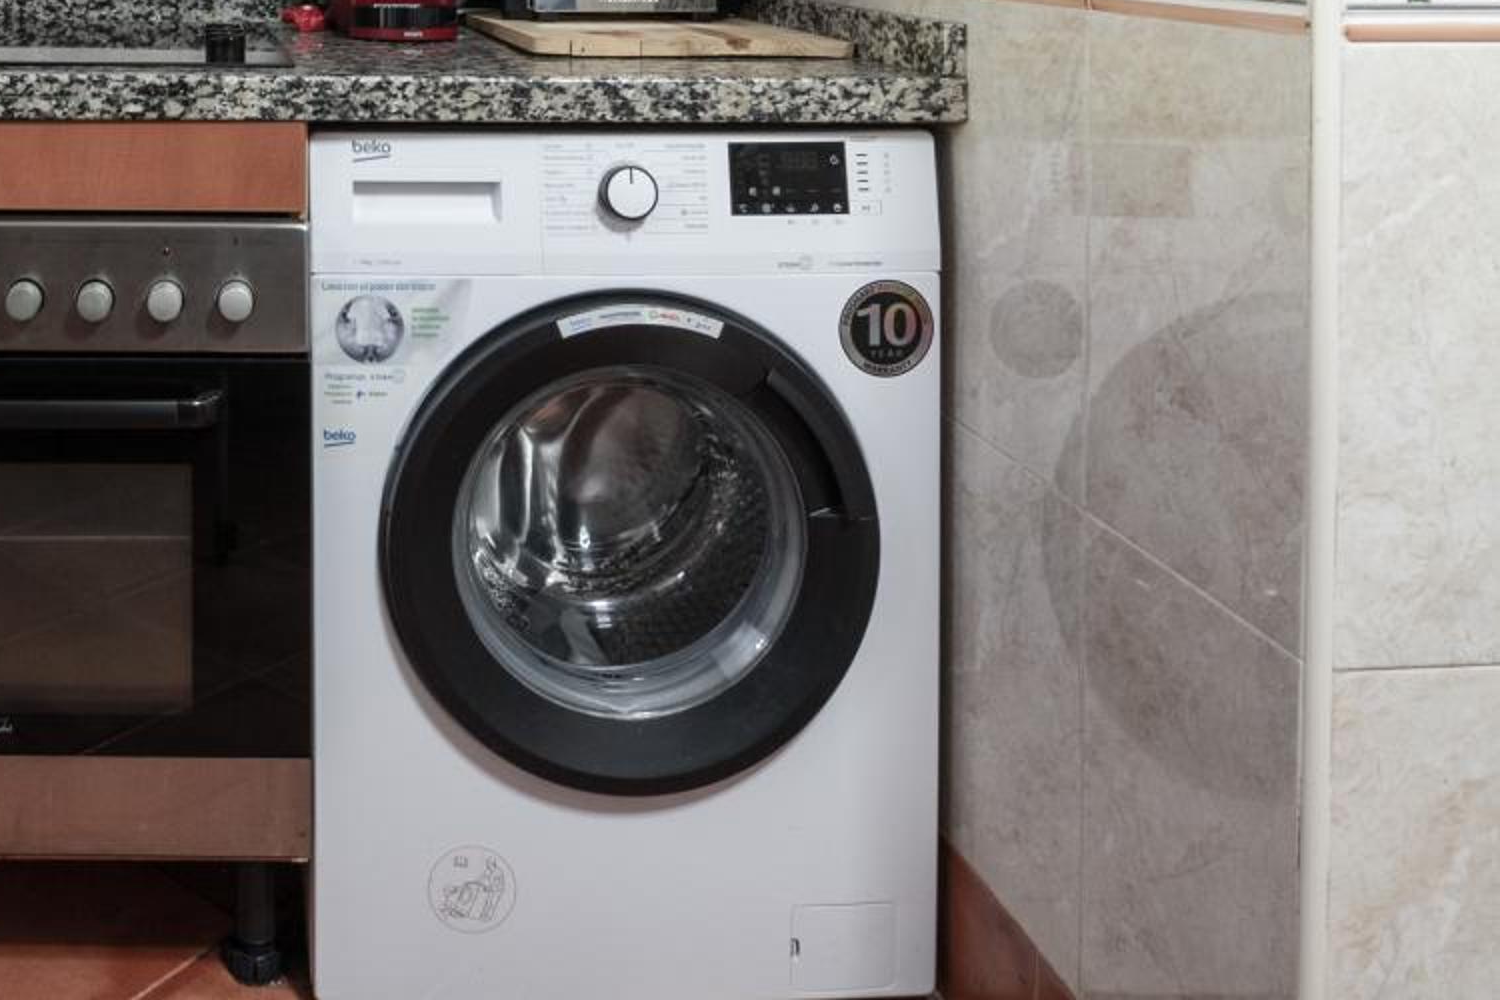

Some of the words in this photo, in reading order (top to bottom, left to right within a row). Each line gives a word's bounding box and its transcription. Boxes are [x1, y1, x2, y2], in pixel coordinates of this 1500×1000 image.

[352, 138, 391, 153] beko
[857, 303, 917, 346] 10
[323, 430, 357, 441] beko
